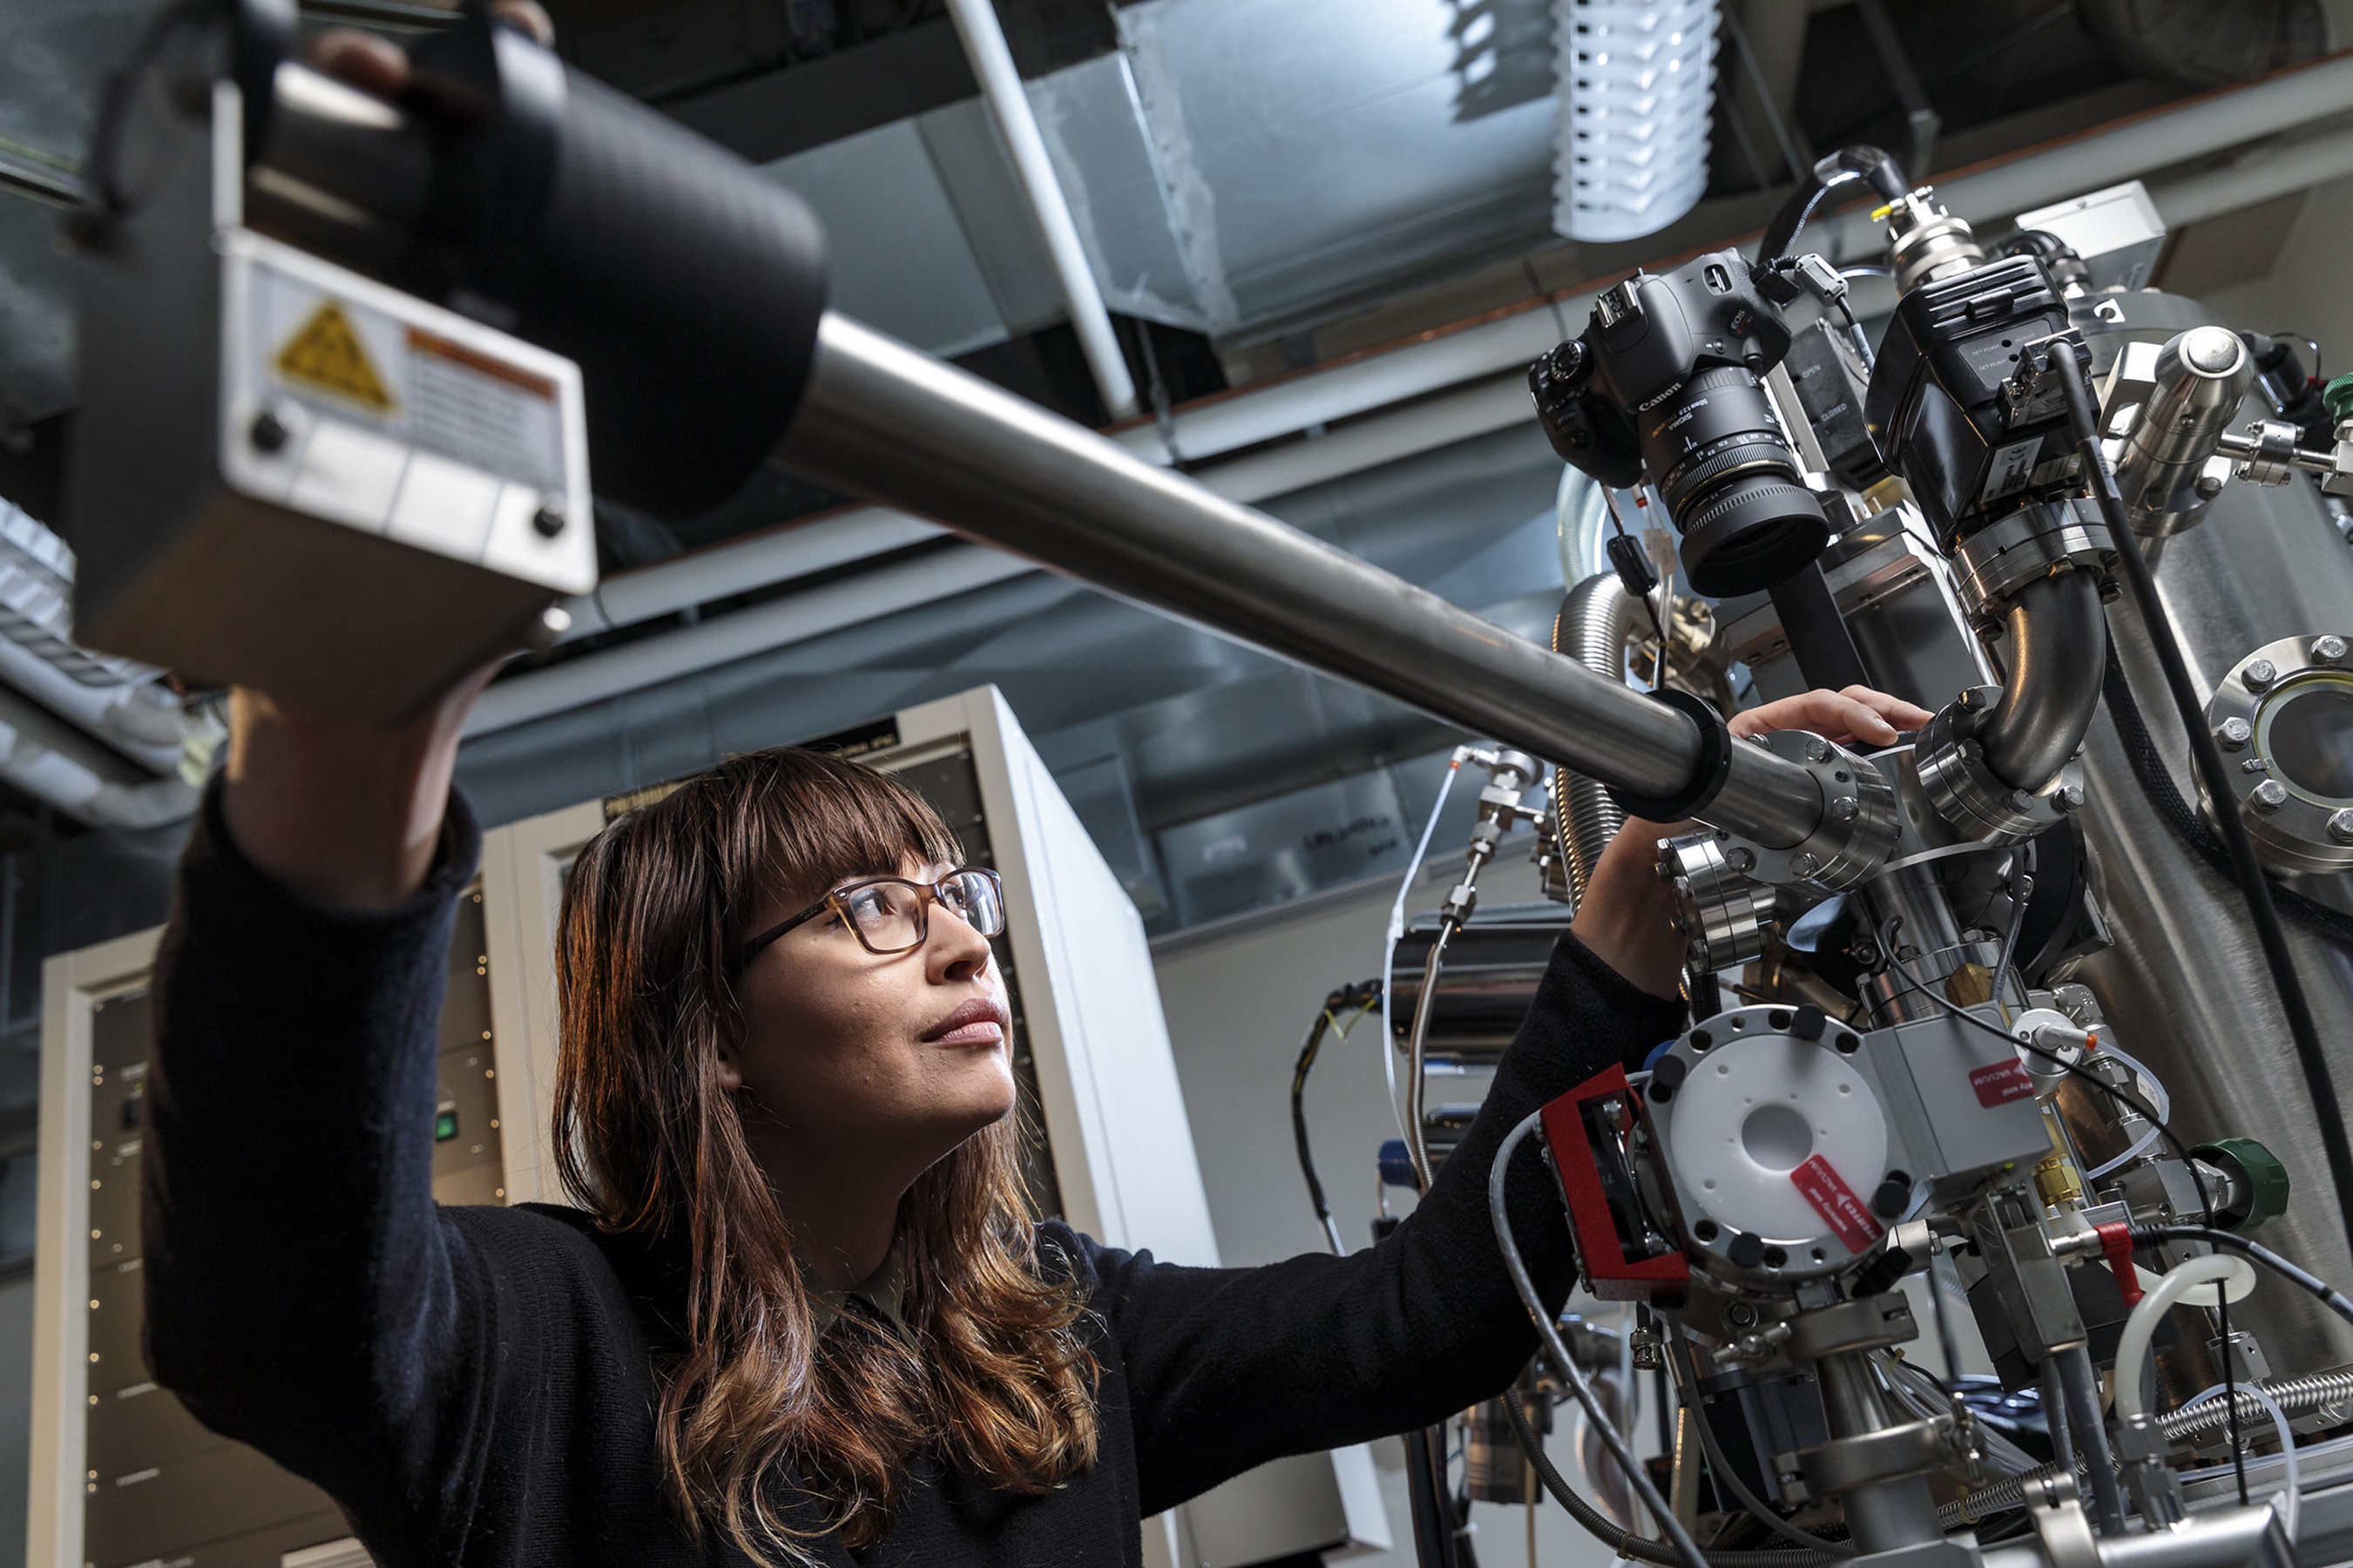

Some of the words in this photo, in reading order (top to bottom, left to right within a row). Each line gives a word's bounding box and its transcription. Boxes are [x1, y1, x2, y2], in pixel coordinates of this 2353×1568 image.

[1731, 309, 1745, 329] EOS
[1802, 363, 1821, 378] OPEN
[1639, 382, 1682, 412] Canon
[1668, 412, 1693, 430] SIGMA
[1821, 402, 1847, 422] CLOSED
[1974, 1069, 2012, 1085] VACUUM
[1809, 1160, 1837, 1193] VACUUM
[1844, 1202, 1877, 1240] PFEIFFER
